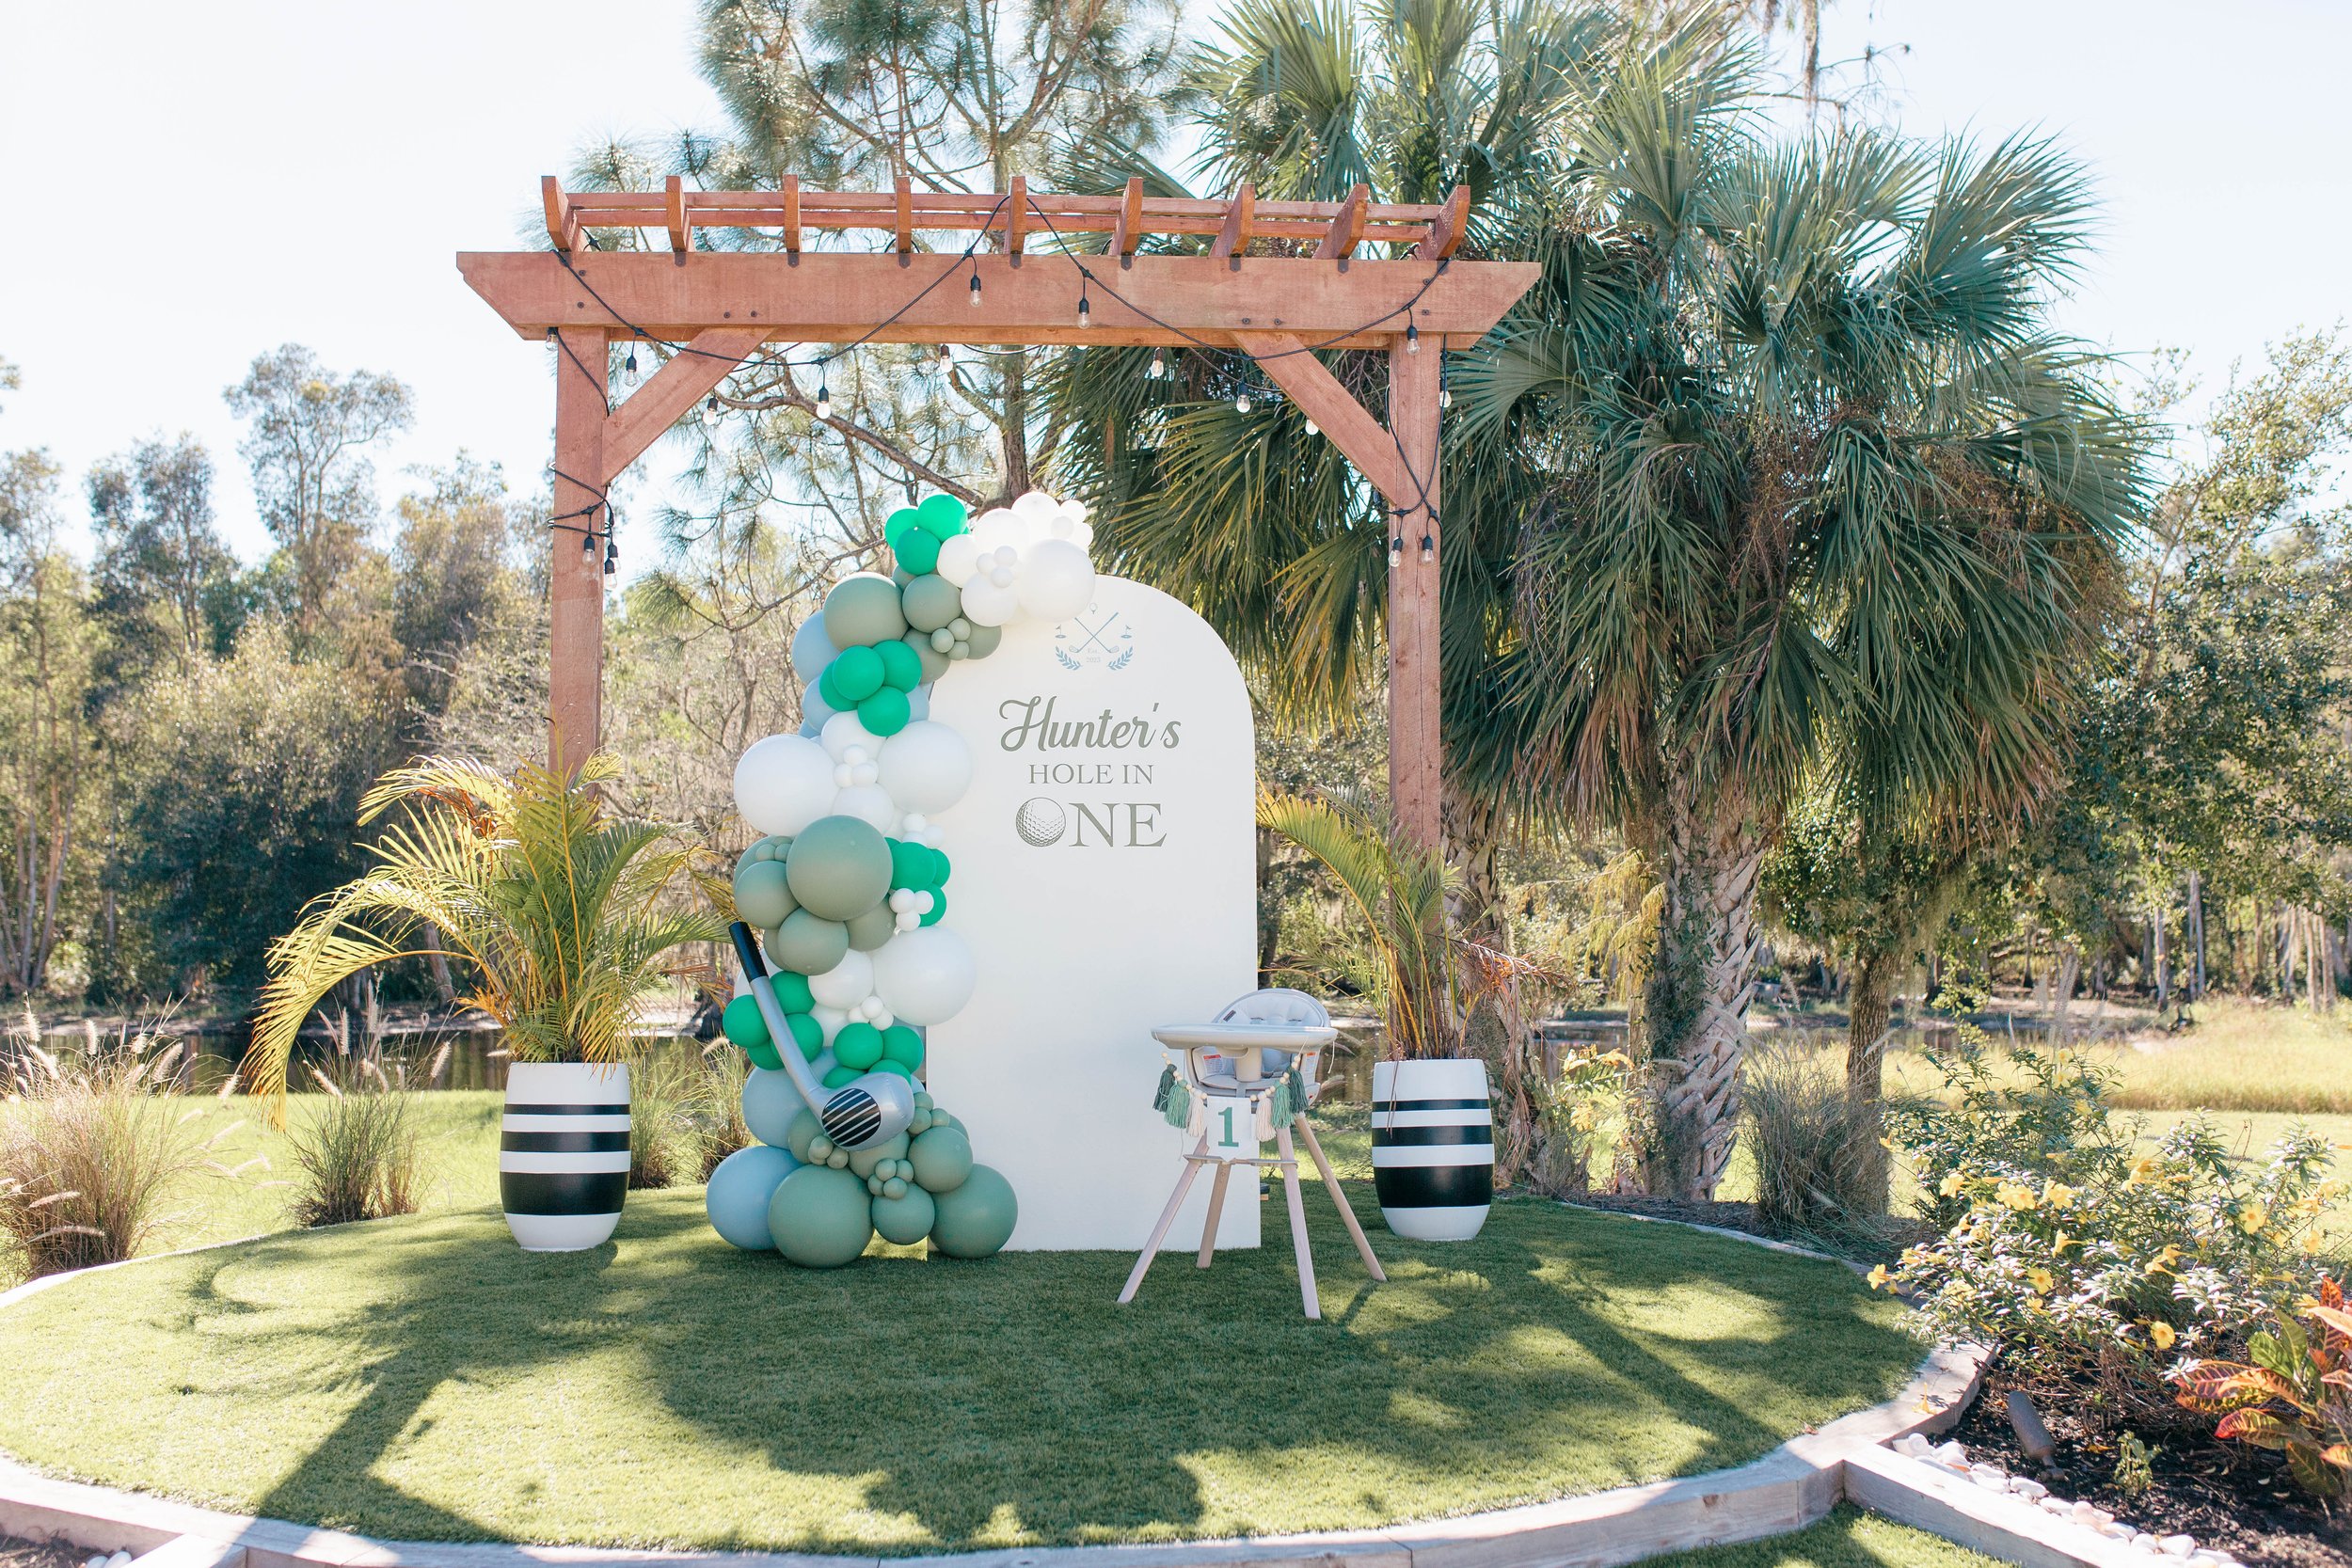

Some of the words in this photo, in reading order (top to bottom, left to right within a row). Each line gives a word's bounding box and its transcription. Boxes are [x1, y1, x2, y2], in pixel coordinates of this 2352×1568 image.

[999, 696, 1182, 752] Hunter's
[1029, 764, 1114, 784] HOLE
[1123, 764, 1155, 784] IN
[1218, 1106, 1239, 1148] 1
